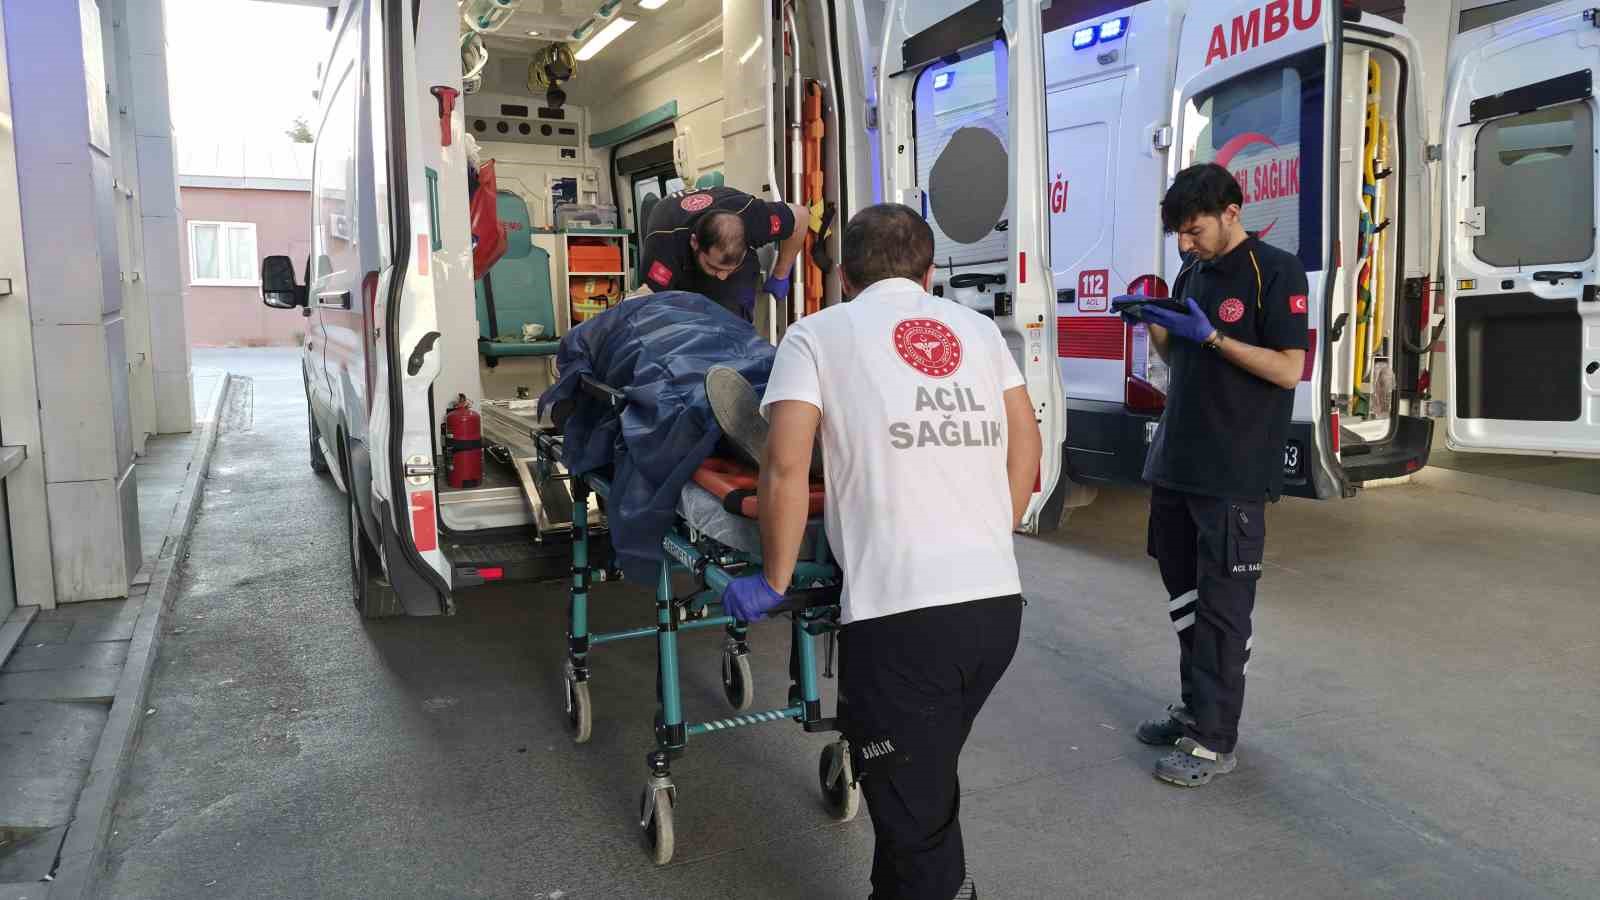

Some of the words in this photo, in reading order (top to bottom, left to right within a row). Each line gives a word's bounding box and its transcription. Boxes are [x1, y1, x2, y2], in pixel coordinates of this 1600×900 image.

[1205, 0, 1322, 67] AMBU
[1254, 157, 1300, 201] SAĞLIK
[1082, 274, 1104, 294] 112
[915, 382, 986, 412] ACİL
[888, 414, 1002, 450] SAĞLIK
